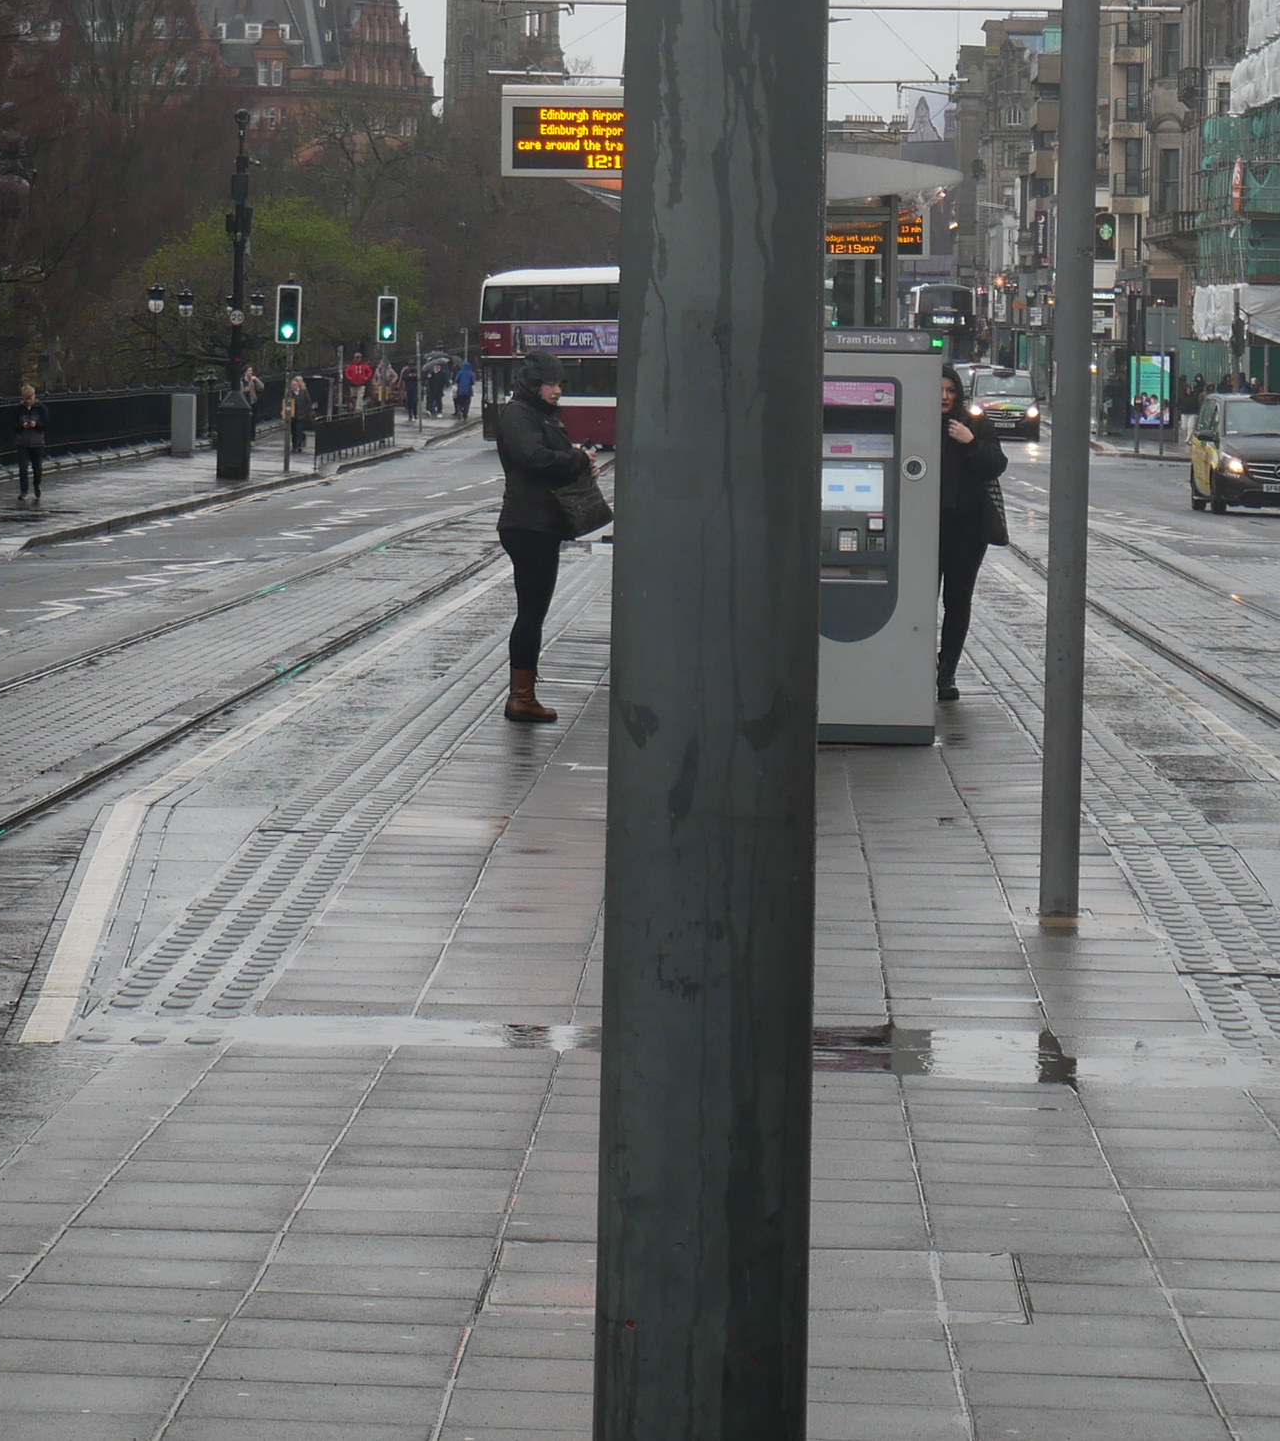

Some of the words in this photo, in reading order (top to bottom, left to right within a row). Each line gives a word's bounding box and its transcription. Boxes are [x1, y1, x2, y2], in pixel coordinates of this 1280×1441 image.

[540, 109, 589, 123] Edinburgh
[592, 110, 624, 123] Airpor
[540, 124, 589, 138] Edinburgh
[592, 125, 624, 138] Airpor
[518, 141, 542, 150] care
[545, 139, 580, 150] around
[583, 139, 601, 150] the
[605, 140, 624, 151] tra
[587, 155, 624, 169] 12:1
[825, 234, 845, 243] odays
[231, 313, 243, 321] 20
[836, 334, 862, 345] Tram
[862, 334, 898, 345] Tickets
